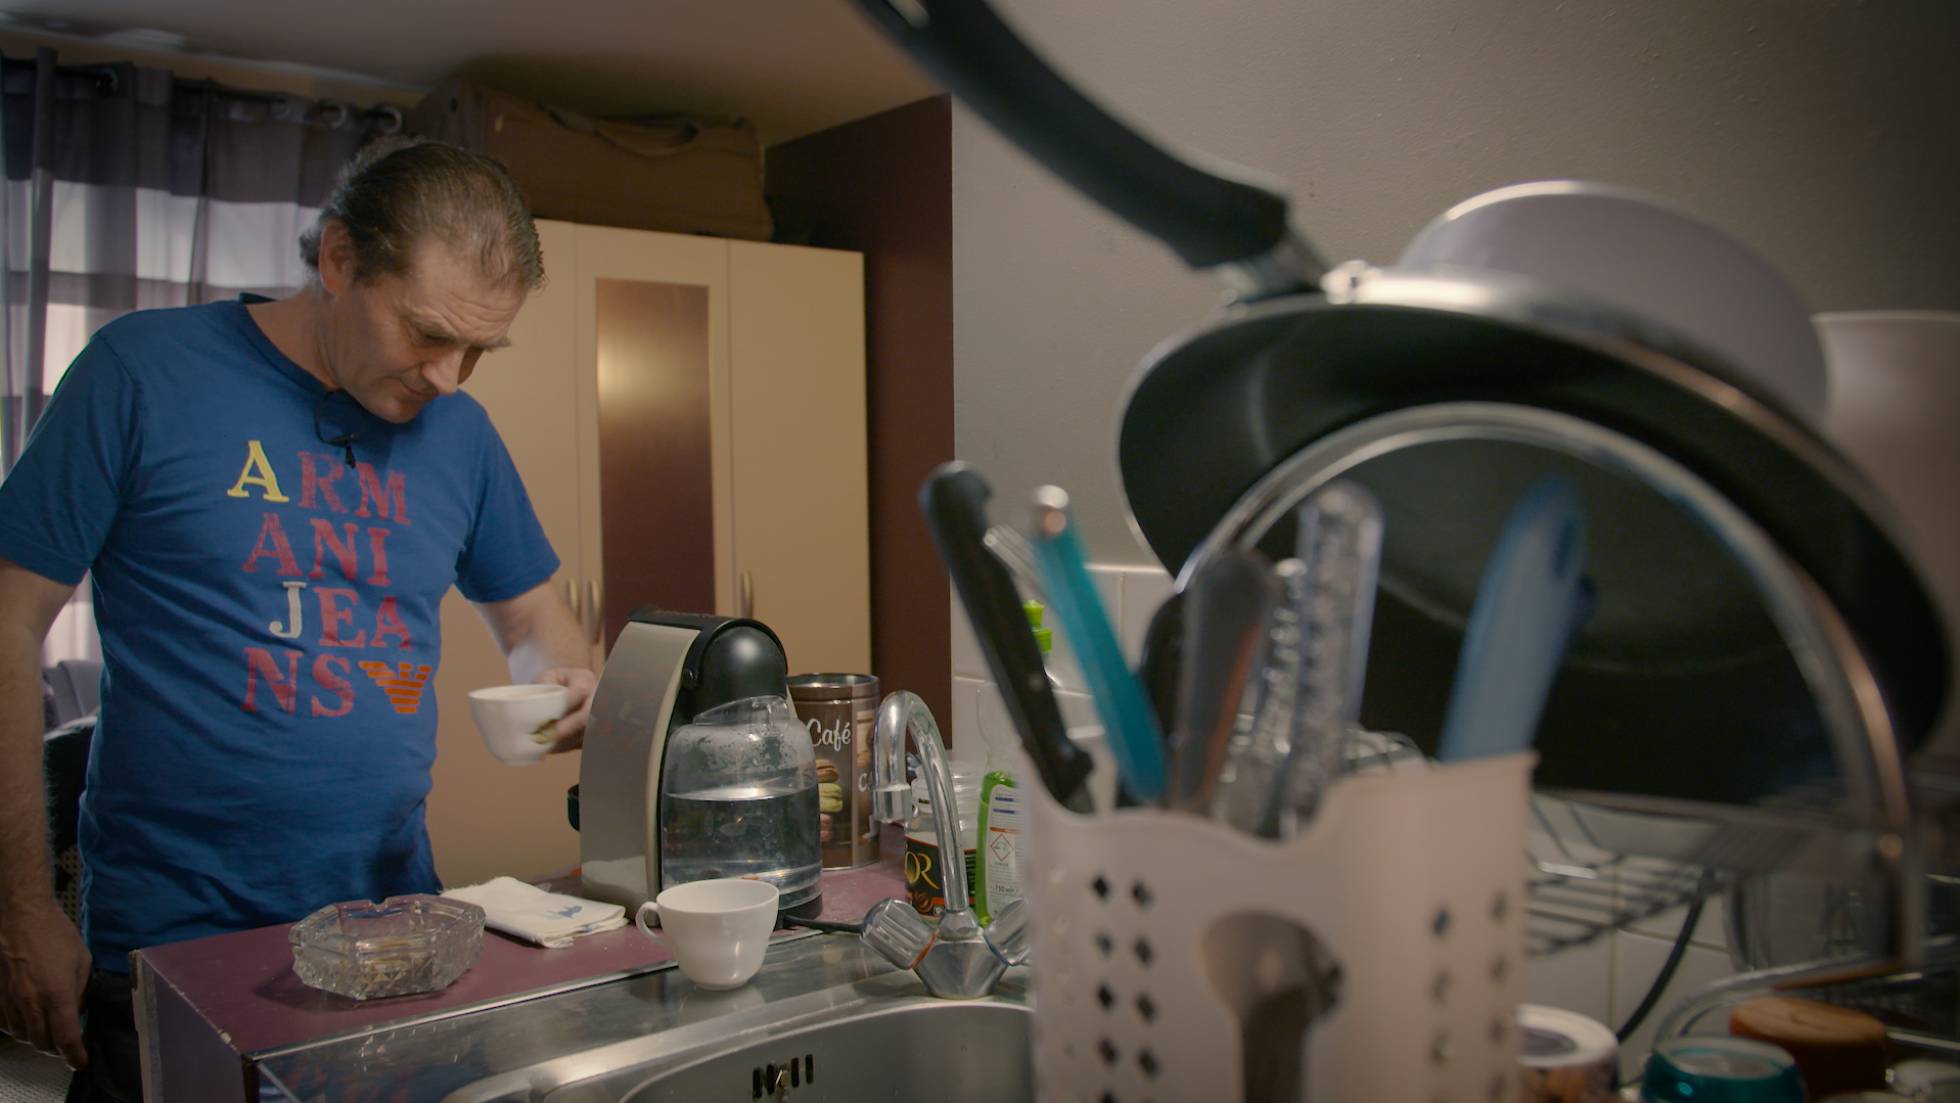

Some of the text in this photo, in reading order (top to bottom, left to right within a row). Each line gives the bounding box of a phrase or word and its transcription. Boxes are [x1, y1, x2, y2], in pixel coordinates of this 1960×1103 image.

[227, 440, 411, 525] ARM
[241, 511, 392, 586] ANI
[268, 581, 411, 648] JEA
[240, 646, 355, 717] NS
[807, 718, 851, 751] Café
